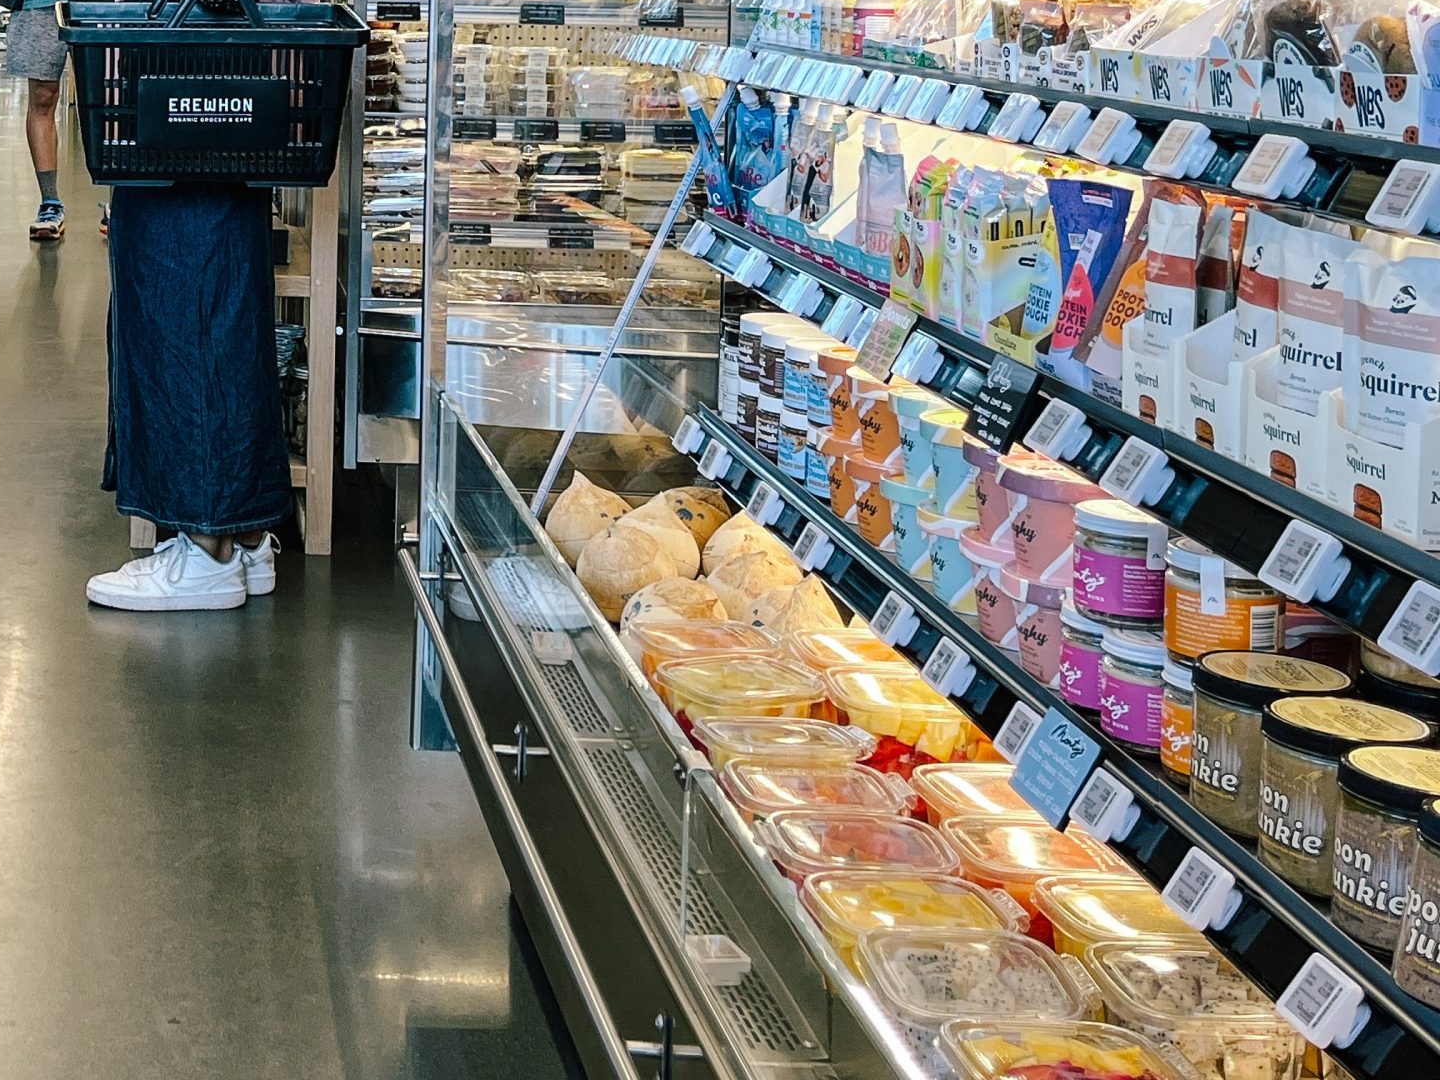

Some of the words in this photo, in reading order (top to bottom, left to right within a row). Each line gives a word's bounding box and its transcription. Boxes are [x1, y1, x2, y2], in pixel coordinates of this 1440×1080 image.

[1210, 69, 1233, 108] WBS
[1276, 77, 1304, 118] WBS
[168, 98, 253, 112] EREWHON
[1355, 85, 1385, 129] WBS
[1027, 293, 1050, 313] OOKIE
[1111, 300, 1144, 319] COO
[1118, 289, 1145, 308] PROT
[1025, 305, 1048, 325] OUGH
[1105, 312, 1124, 331] DOU
[1056, 324, 1083, 340] UGH
[1280, 343, 1343, 372] quirrel
[1263, 423, 1301, 446] squirrel
[1346, 454, 1386, 480] squirrel
[1192, 756, 1239, 794] nkie
[1334, 868, 1408, 916] unkie
